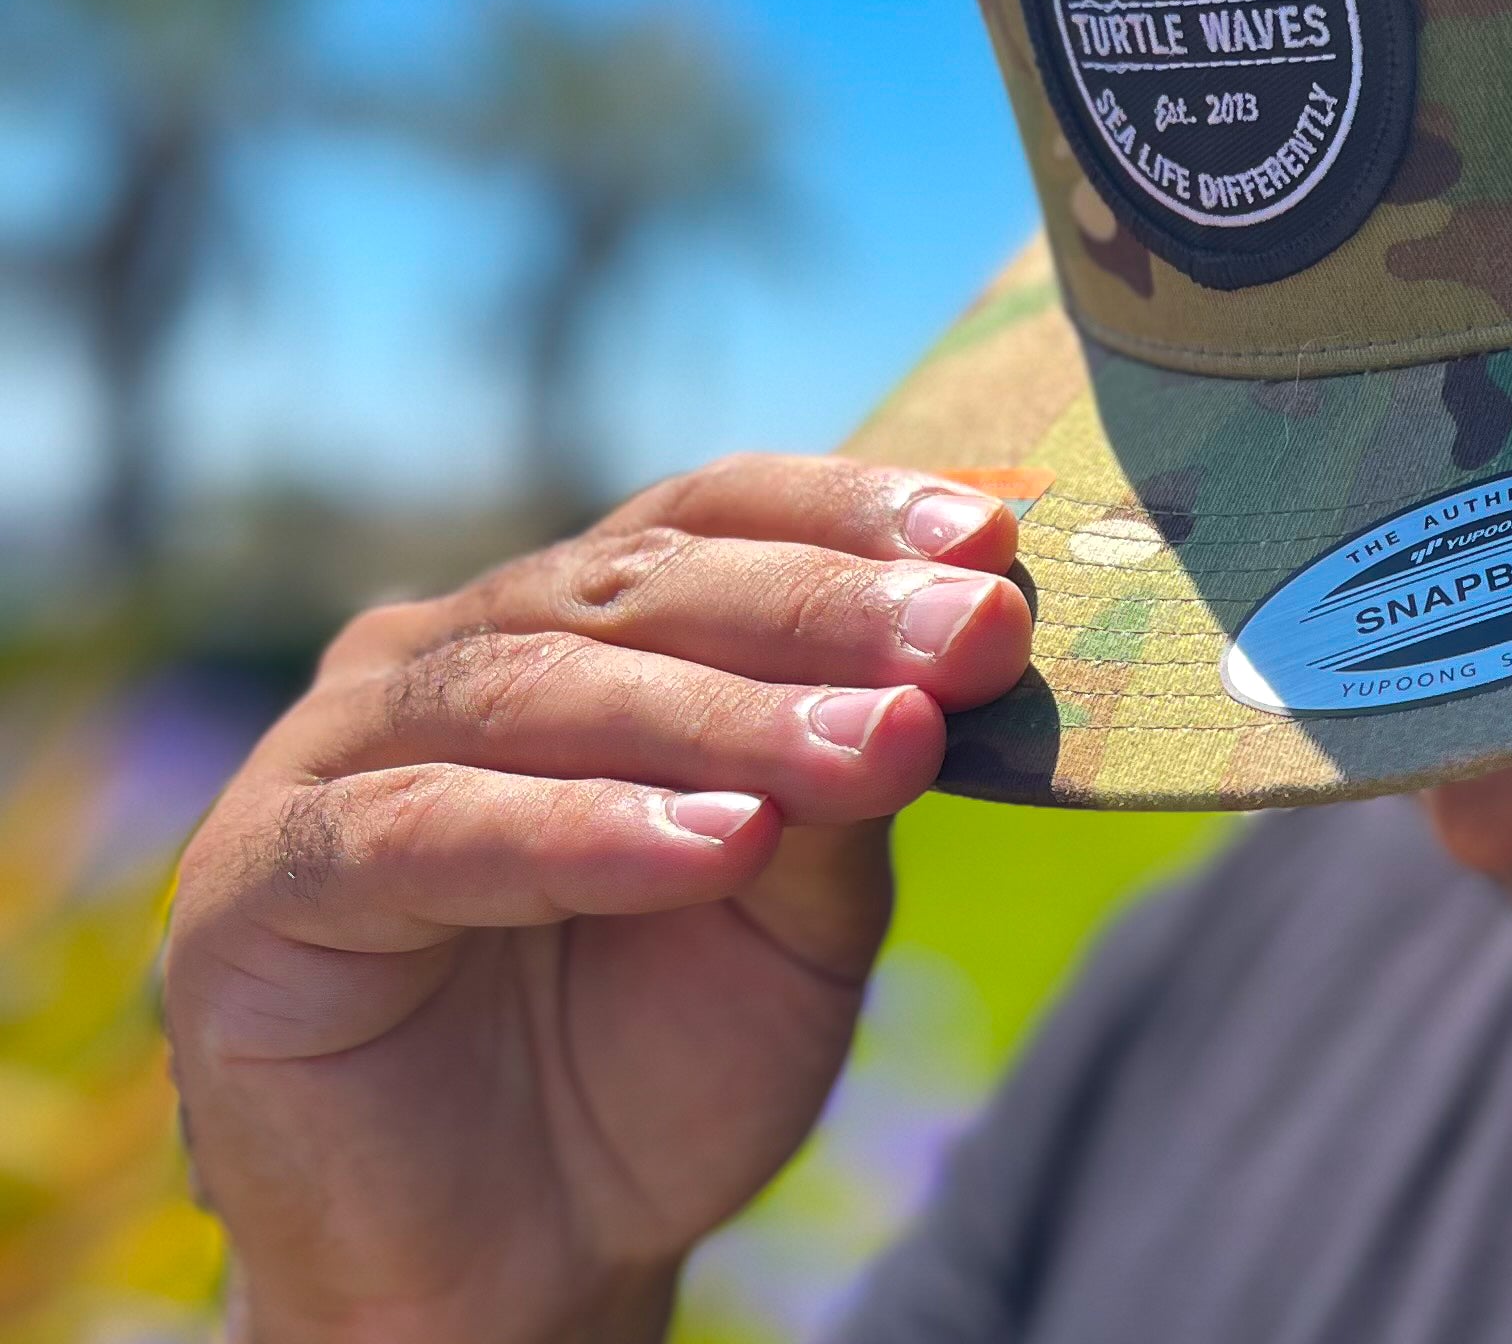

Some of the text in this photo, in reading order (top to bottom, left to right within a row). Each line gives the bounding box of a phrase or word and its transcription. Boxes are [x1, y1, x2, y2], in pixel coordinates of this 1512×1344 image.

[1071, 5, 1331, 55] TURTLE WAVES
[1154, 93, 1260, 132] Est. 2013
[1096, 83, 1338, 209] SEA LIFE DIFFERENTLY
[1346, 529, 1401, 564] THE
[1341, 663, 1477, 698] YUPOONG
